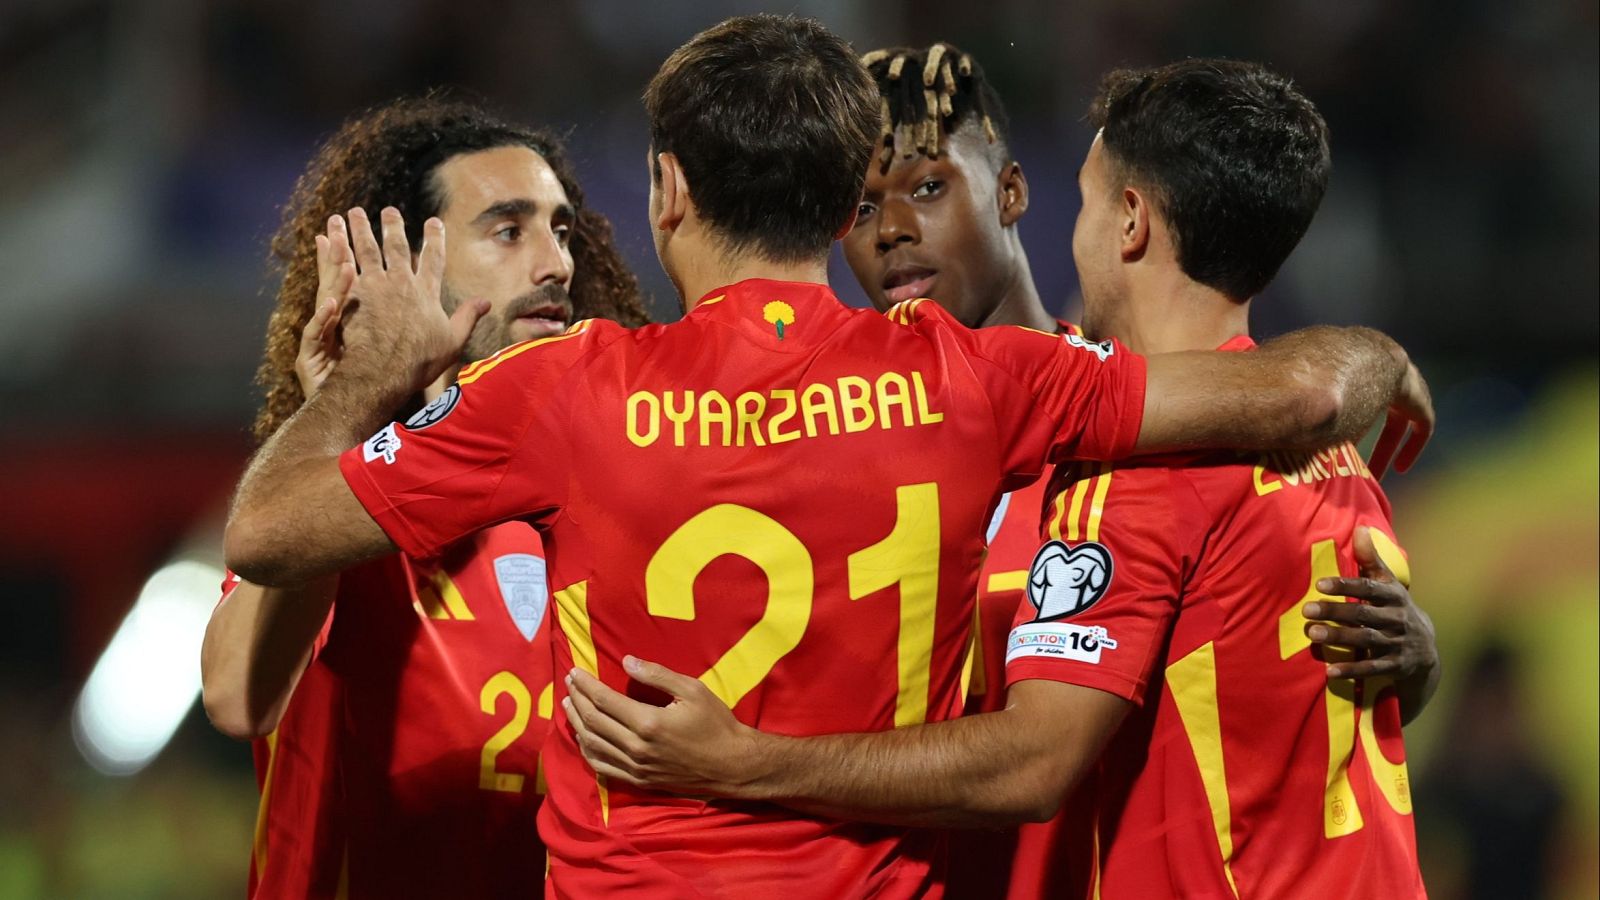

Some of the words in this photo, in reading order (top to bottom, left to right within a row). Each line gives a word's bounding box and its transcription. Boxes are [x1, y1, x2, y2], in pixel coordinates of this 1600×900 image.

[626, 371, 944, 447] OYARZABAL
[645, 481, 940, 730] 21
[1069, 632, 1099, 652] 10
[478, 671, 554, 794] 2
